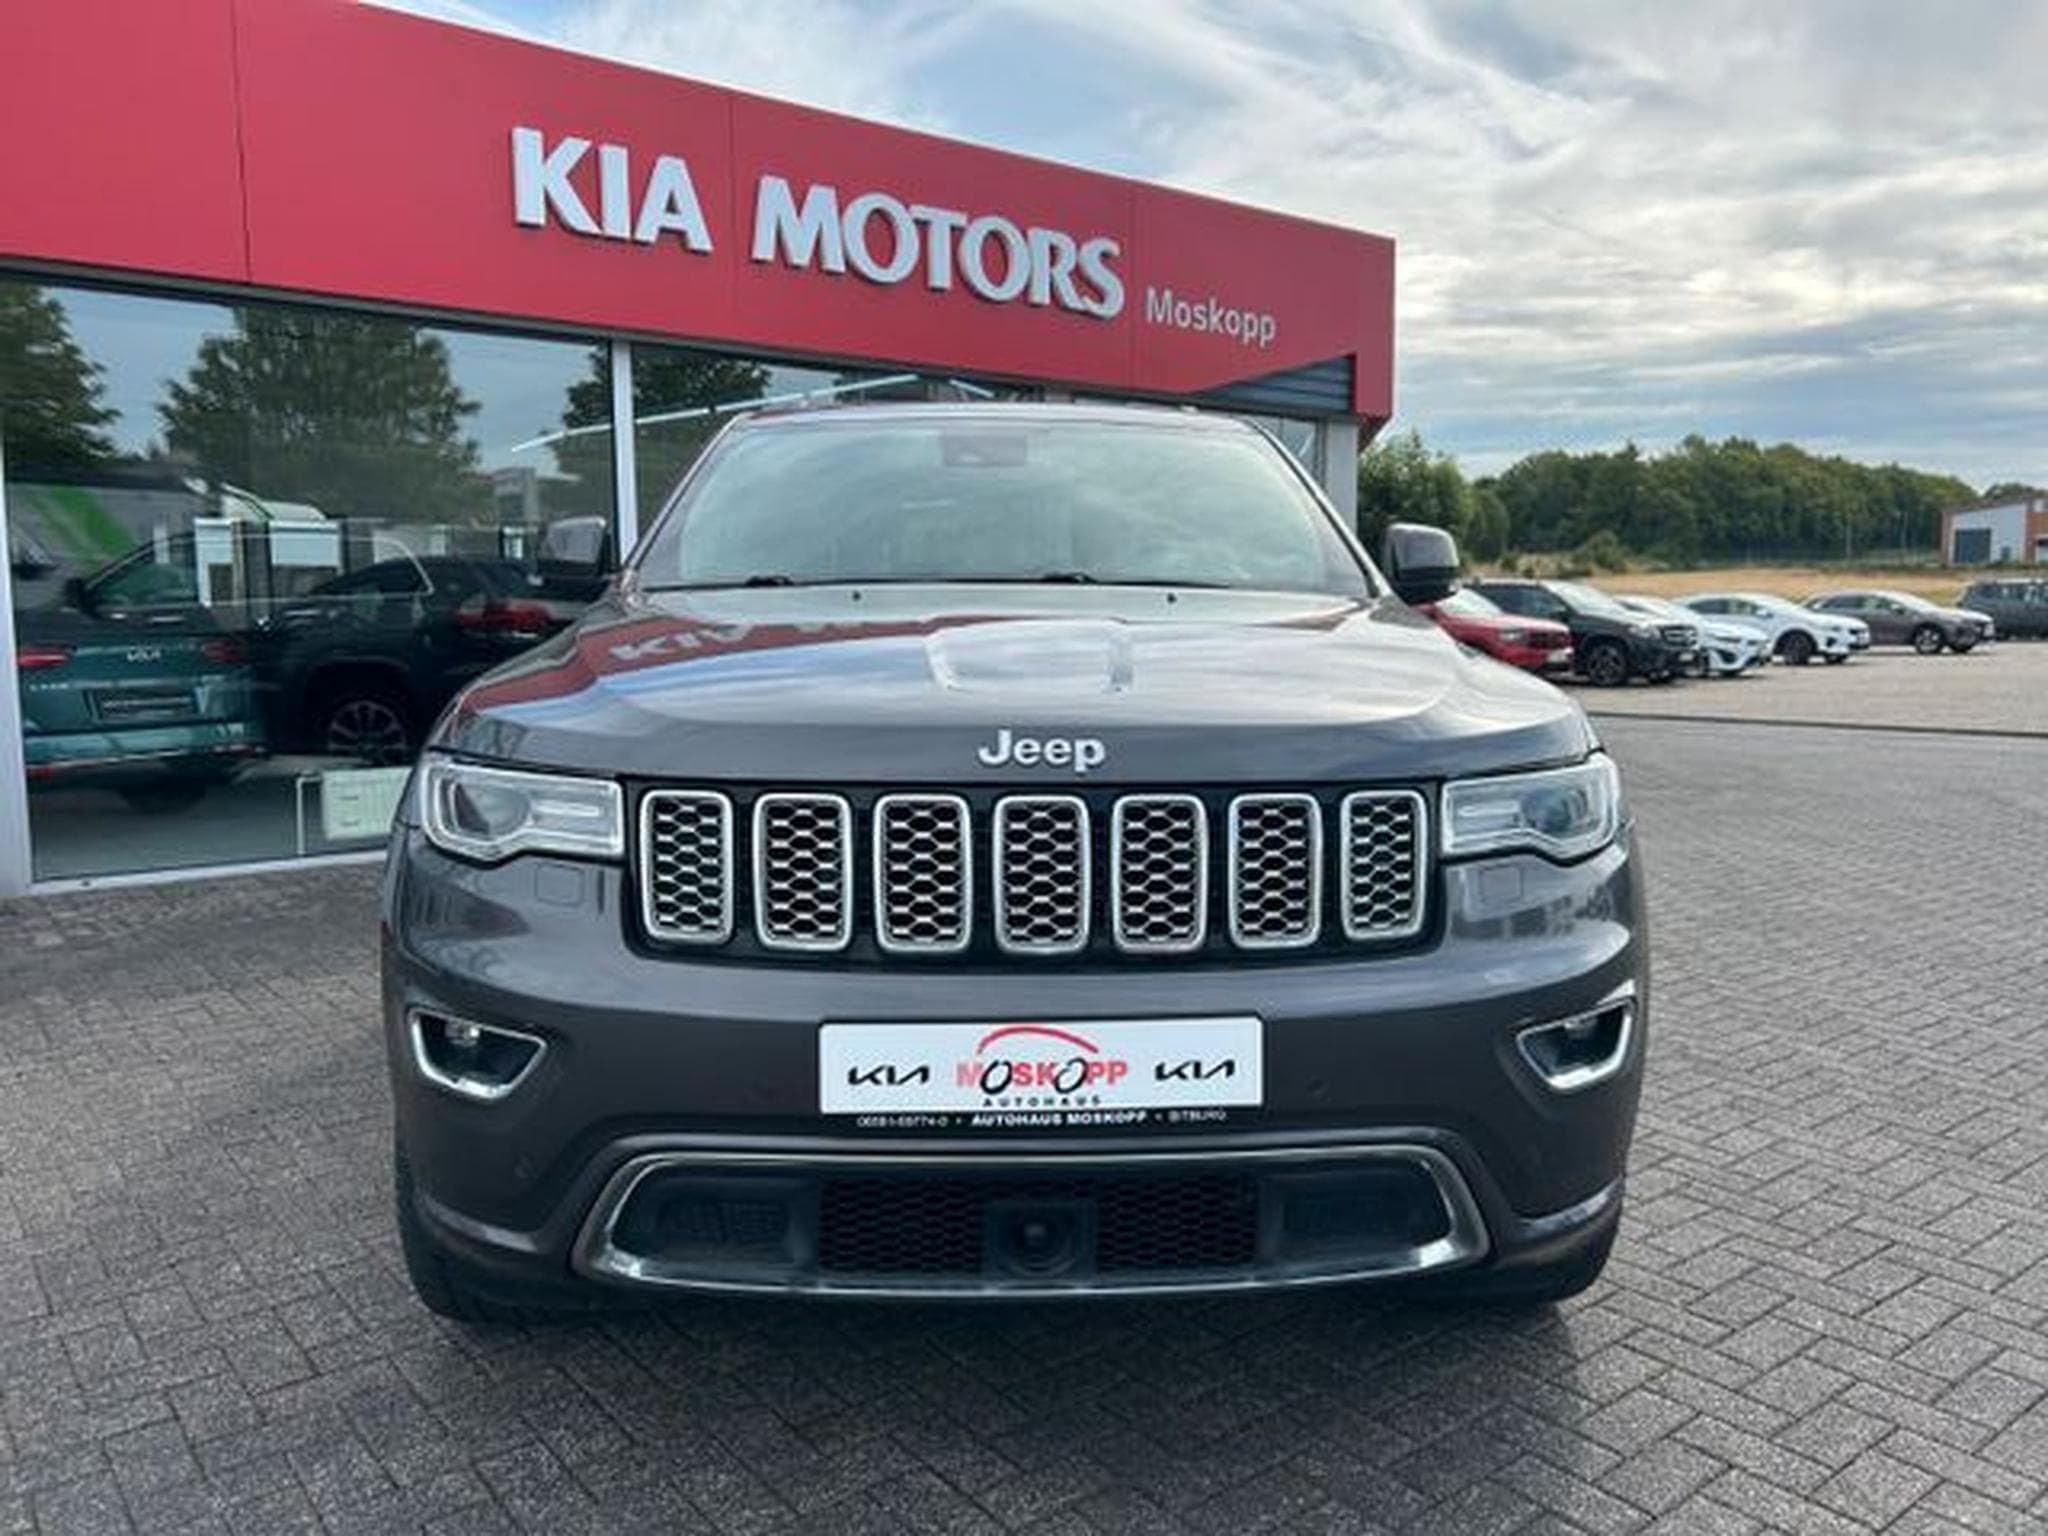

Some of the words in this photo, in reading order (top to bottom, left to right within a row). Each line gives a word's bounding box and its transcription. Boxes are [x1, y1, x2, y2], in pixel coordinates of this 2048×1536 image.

[511, 127, 713, 254] KIA
[751, 175, 1125, 320] MOTORS
[1146, 287, 1276, 347] Moskopp
[978, 730, 1106, 774] Jeep
[848, 1066, 930, 1086] KIA
[956, 1057, 1128, 1094] MOSKOPP
[1155, 1059, 1236, 1081] KIA
[982, 1095, 1102, 1107] AUTOHAUS
[971, 1112, 1063, 1127] AUTOHAUS
[1066, 1110, 1147, 1126] MOSKOPP
